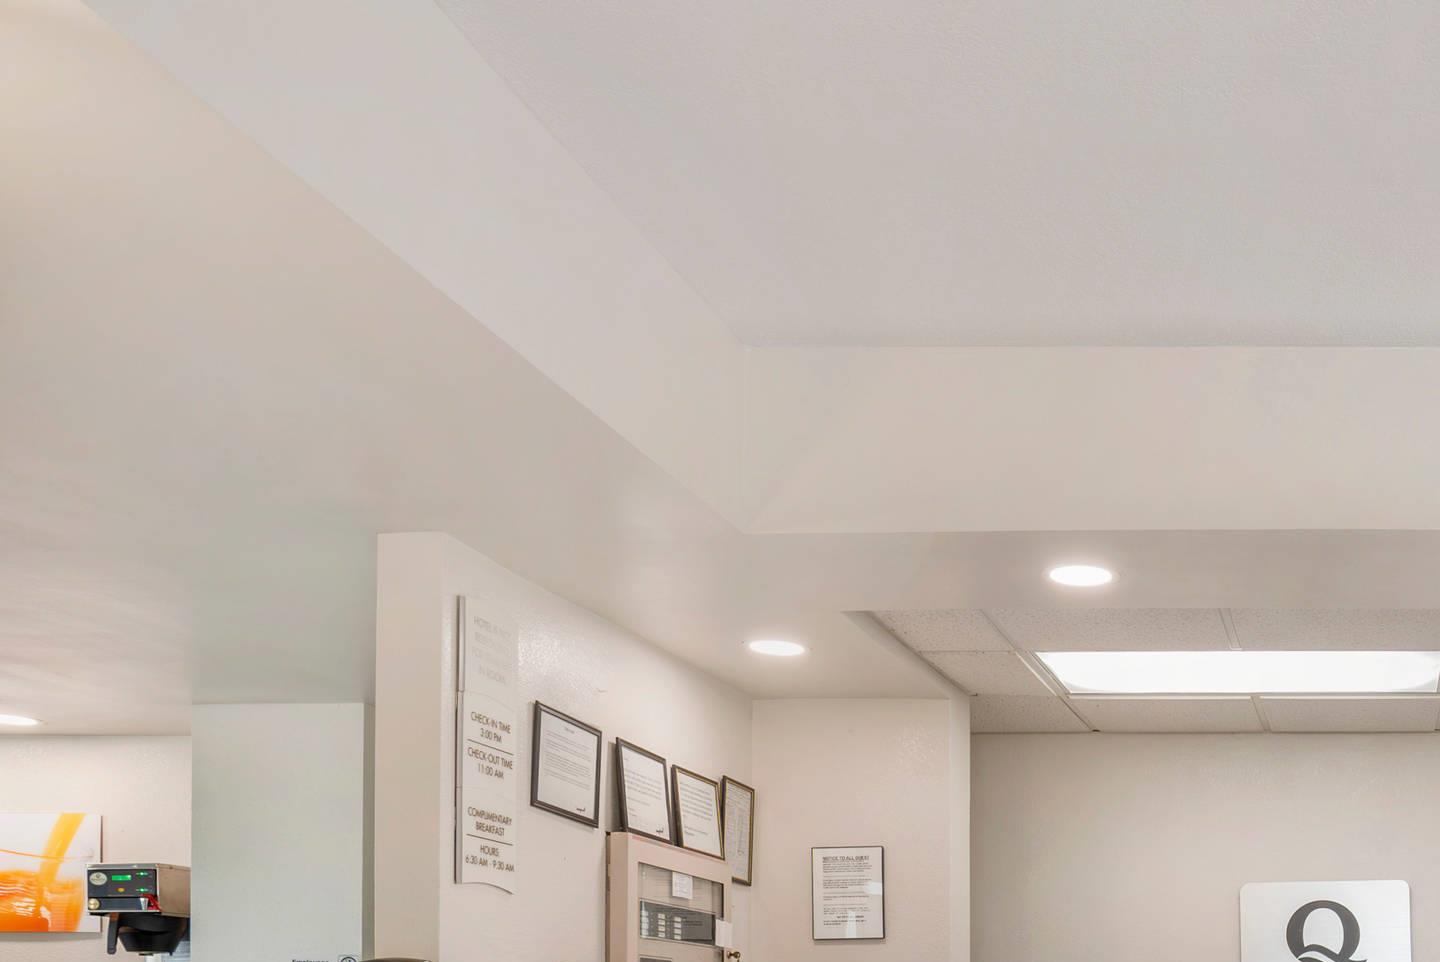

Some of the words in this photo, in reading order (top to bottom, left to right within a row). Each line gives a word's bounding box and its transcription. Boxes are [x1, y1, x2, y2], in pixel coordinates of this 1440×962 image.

[471, 711, 498, 728] CHECK-IN
[498, 721, 512, 734] TIME
[480, 727, 492, 740] 3:00
[493, 732, 502, 743] PM
[468, 747, 500, 765] CHECK-OUT
[501, 757, 513, 770] TIME
[478, 763, 493, 776] 11:00
[494, 769, 504, 779] AM
[476, 822, 504, 836] BREAKFAST
[478, 857, 488, 867] AM
[505, 863, 515, 873] AM
